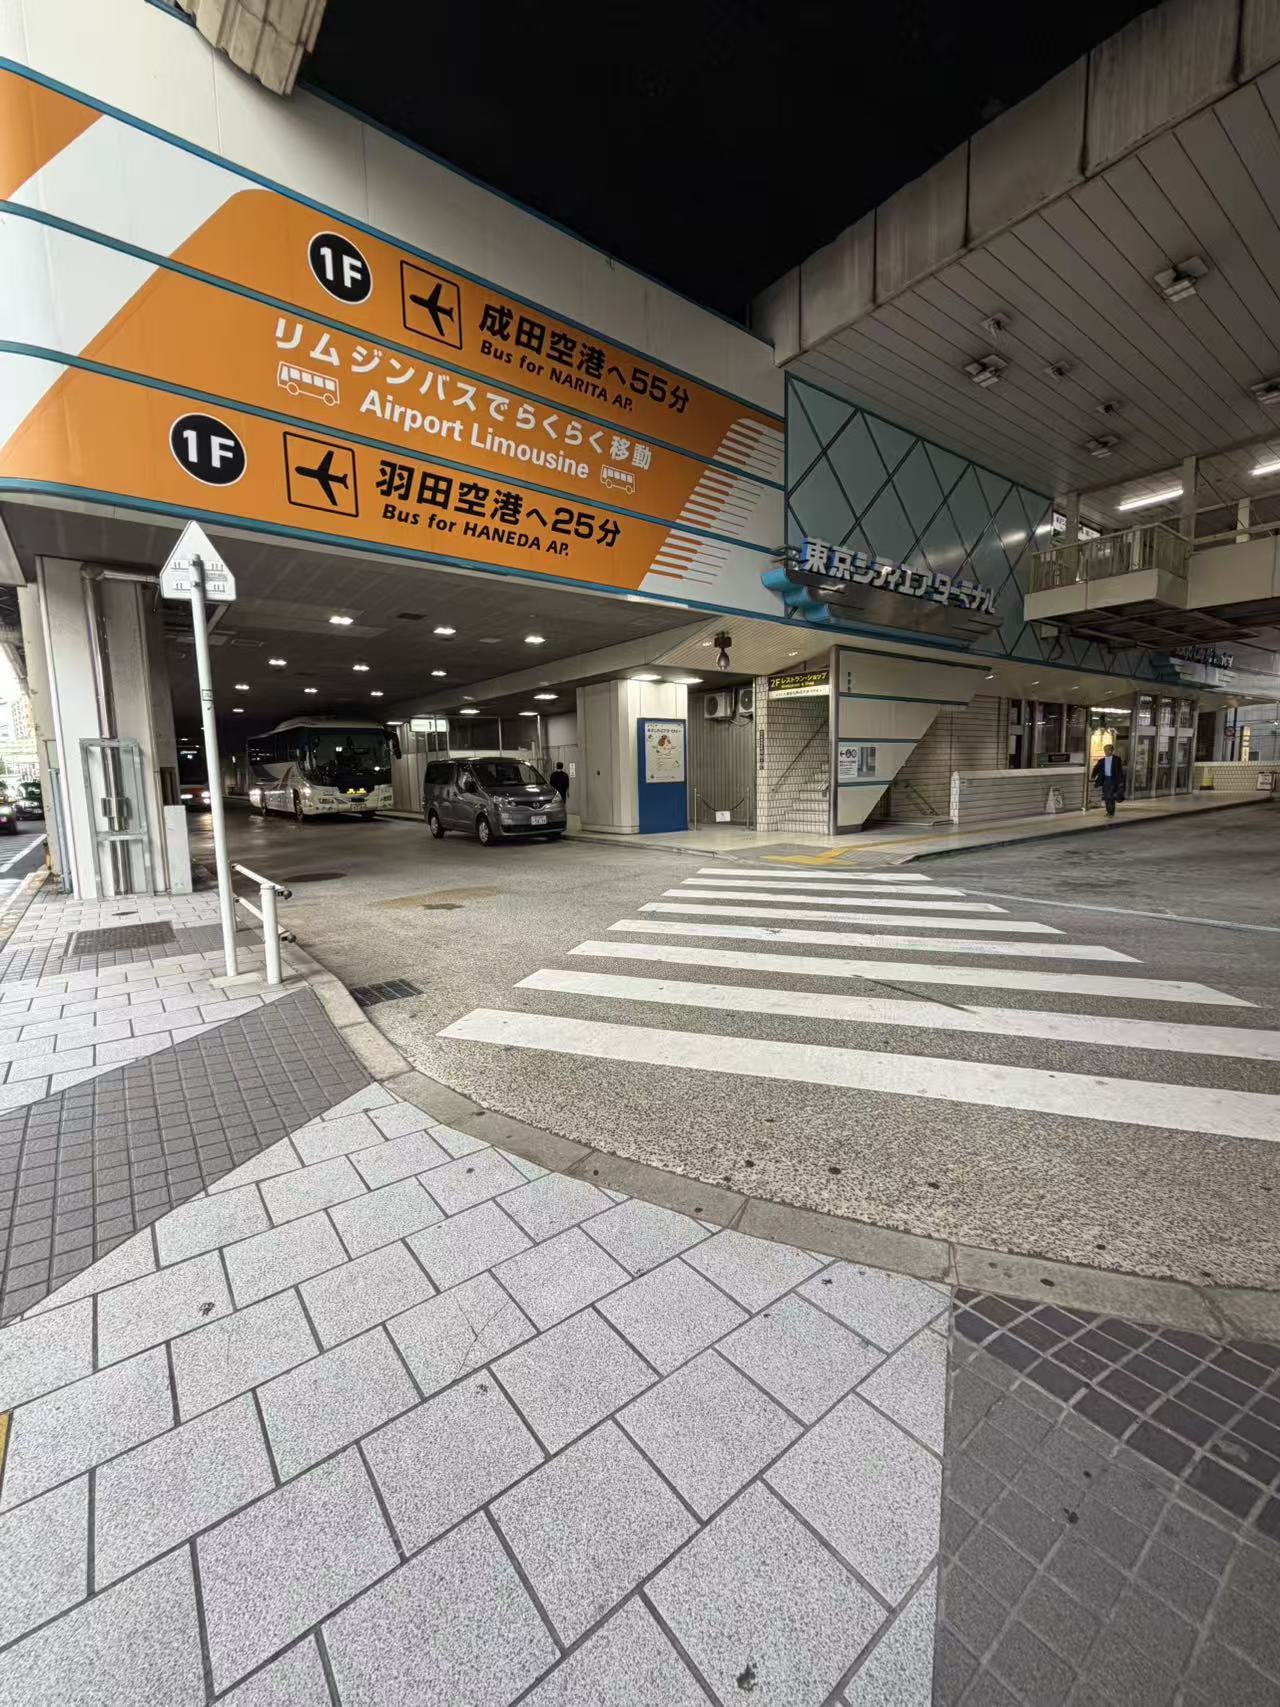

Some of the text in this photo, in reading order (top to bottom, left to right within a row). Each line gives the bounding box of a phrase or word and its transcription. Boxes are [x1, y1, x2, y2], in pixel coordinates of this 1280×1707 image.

[320, 246, 363, 289] 1F
[275, 317, 653, 470] リムジンバスでらくらく移動
[479, 303, 691, 415] 成田空港へ55分
[480, 339, 634, 412] Bus for NARITA AP.
[182, 429, 236, 469] 1F
[359, 389, 589, 479] Airport Limousine
[375, 459, 622, 548] 羽田空港へ25分
[382, 503, 570, 557] Bus for HANEDA AP.
